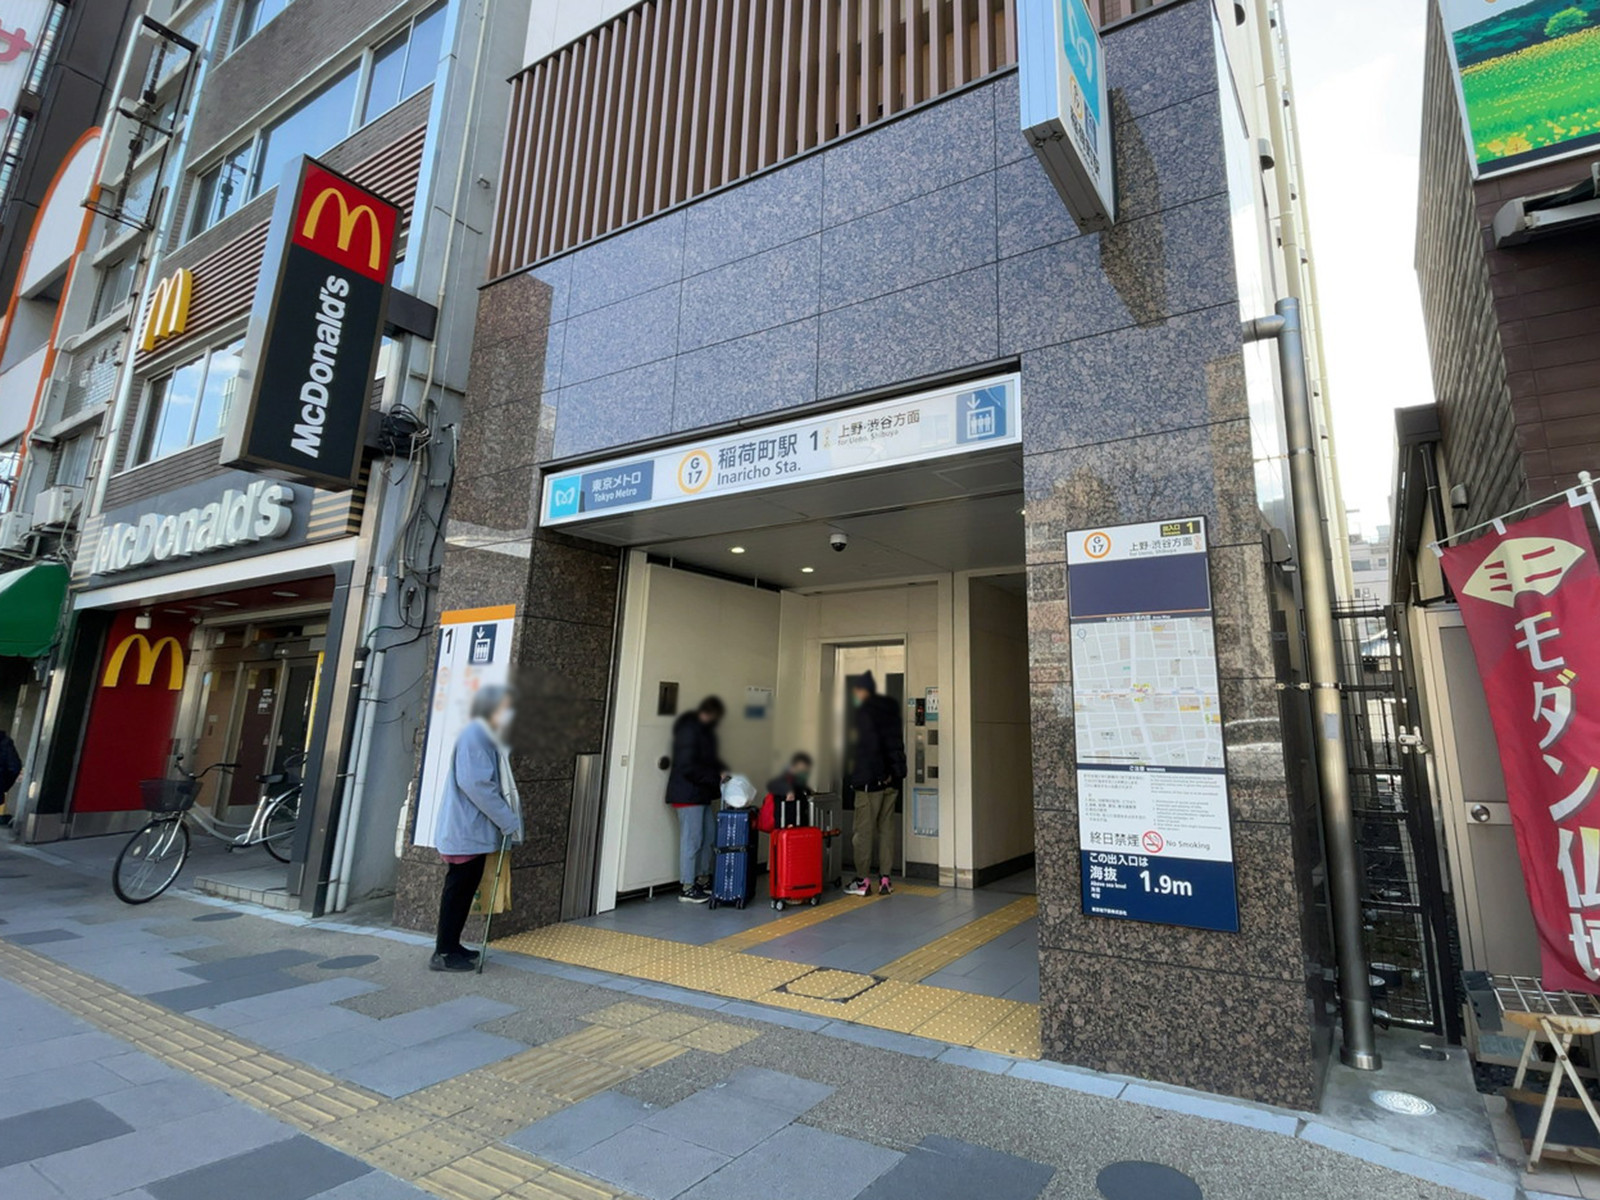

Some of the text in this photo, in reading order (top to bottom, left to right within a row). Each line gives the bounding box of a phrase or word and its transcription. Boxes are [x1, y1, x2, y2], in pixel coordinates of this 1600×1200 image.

[290, 274, 351, 459] McDonald's
[809, 430, 818, 451] 1
[718, 434, 798, 470] 稲荷町駅
[690, 457, 700, 470] G
[718, 460, 802, 486] Inaricho Sta.
[591, 471, 641, 493] 東京メトロ
[687, 471, 703, 484] 17
[593, 487, 638, 503] Tokyo Metro
[92, 480, 295, 577] McDonald's
[1186, 521, 1194, 534] 1
[1092, 544, 1104, 554] 17
[1093, 536, 1102, 545] G
[444, 628, 454, 655] 1
[1089, 831, 1211, 852] 終日禁煙 No Smoking
[1089, 853, 1149, 868] この出入口は
[1089, 865, 1118, 882] 海抜
[1139, 870, 1193, 897] 1.9m
